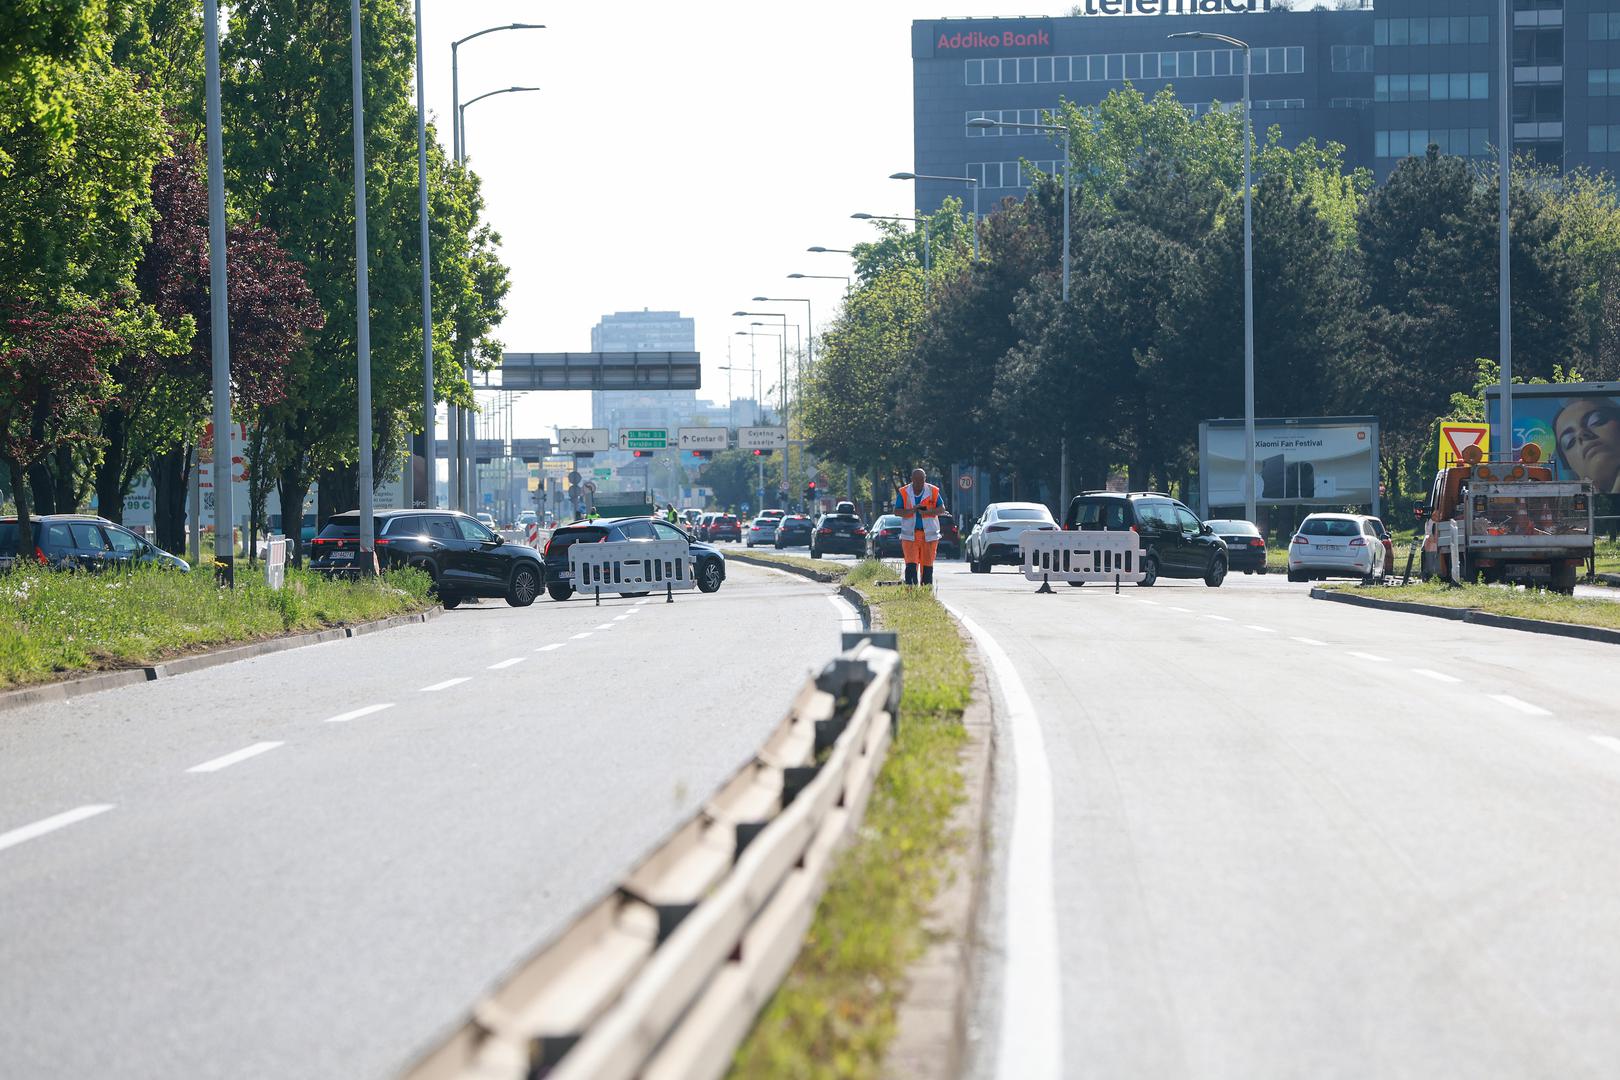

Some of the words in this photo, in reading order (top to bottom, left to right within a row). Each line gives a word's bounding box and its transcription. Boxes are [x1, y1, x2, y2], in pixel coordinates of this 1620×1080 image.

[1085, 0, 1271, 15] telemach
[938, 31, 1000, 49] Addiko
[1003, 29, 1049, 47] Bank
[572, 434, 595, 444] Vrbik
[691, 434, 716, 443] Centar
[1295, 439, 1323, 447] Festival
[962, 478, 970, 486] 70
